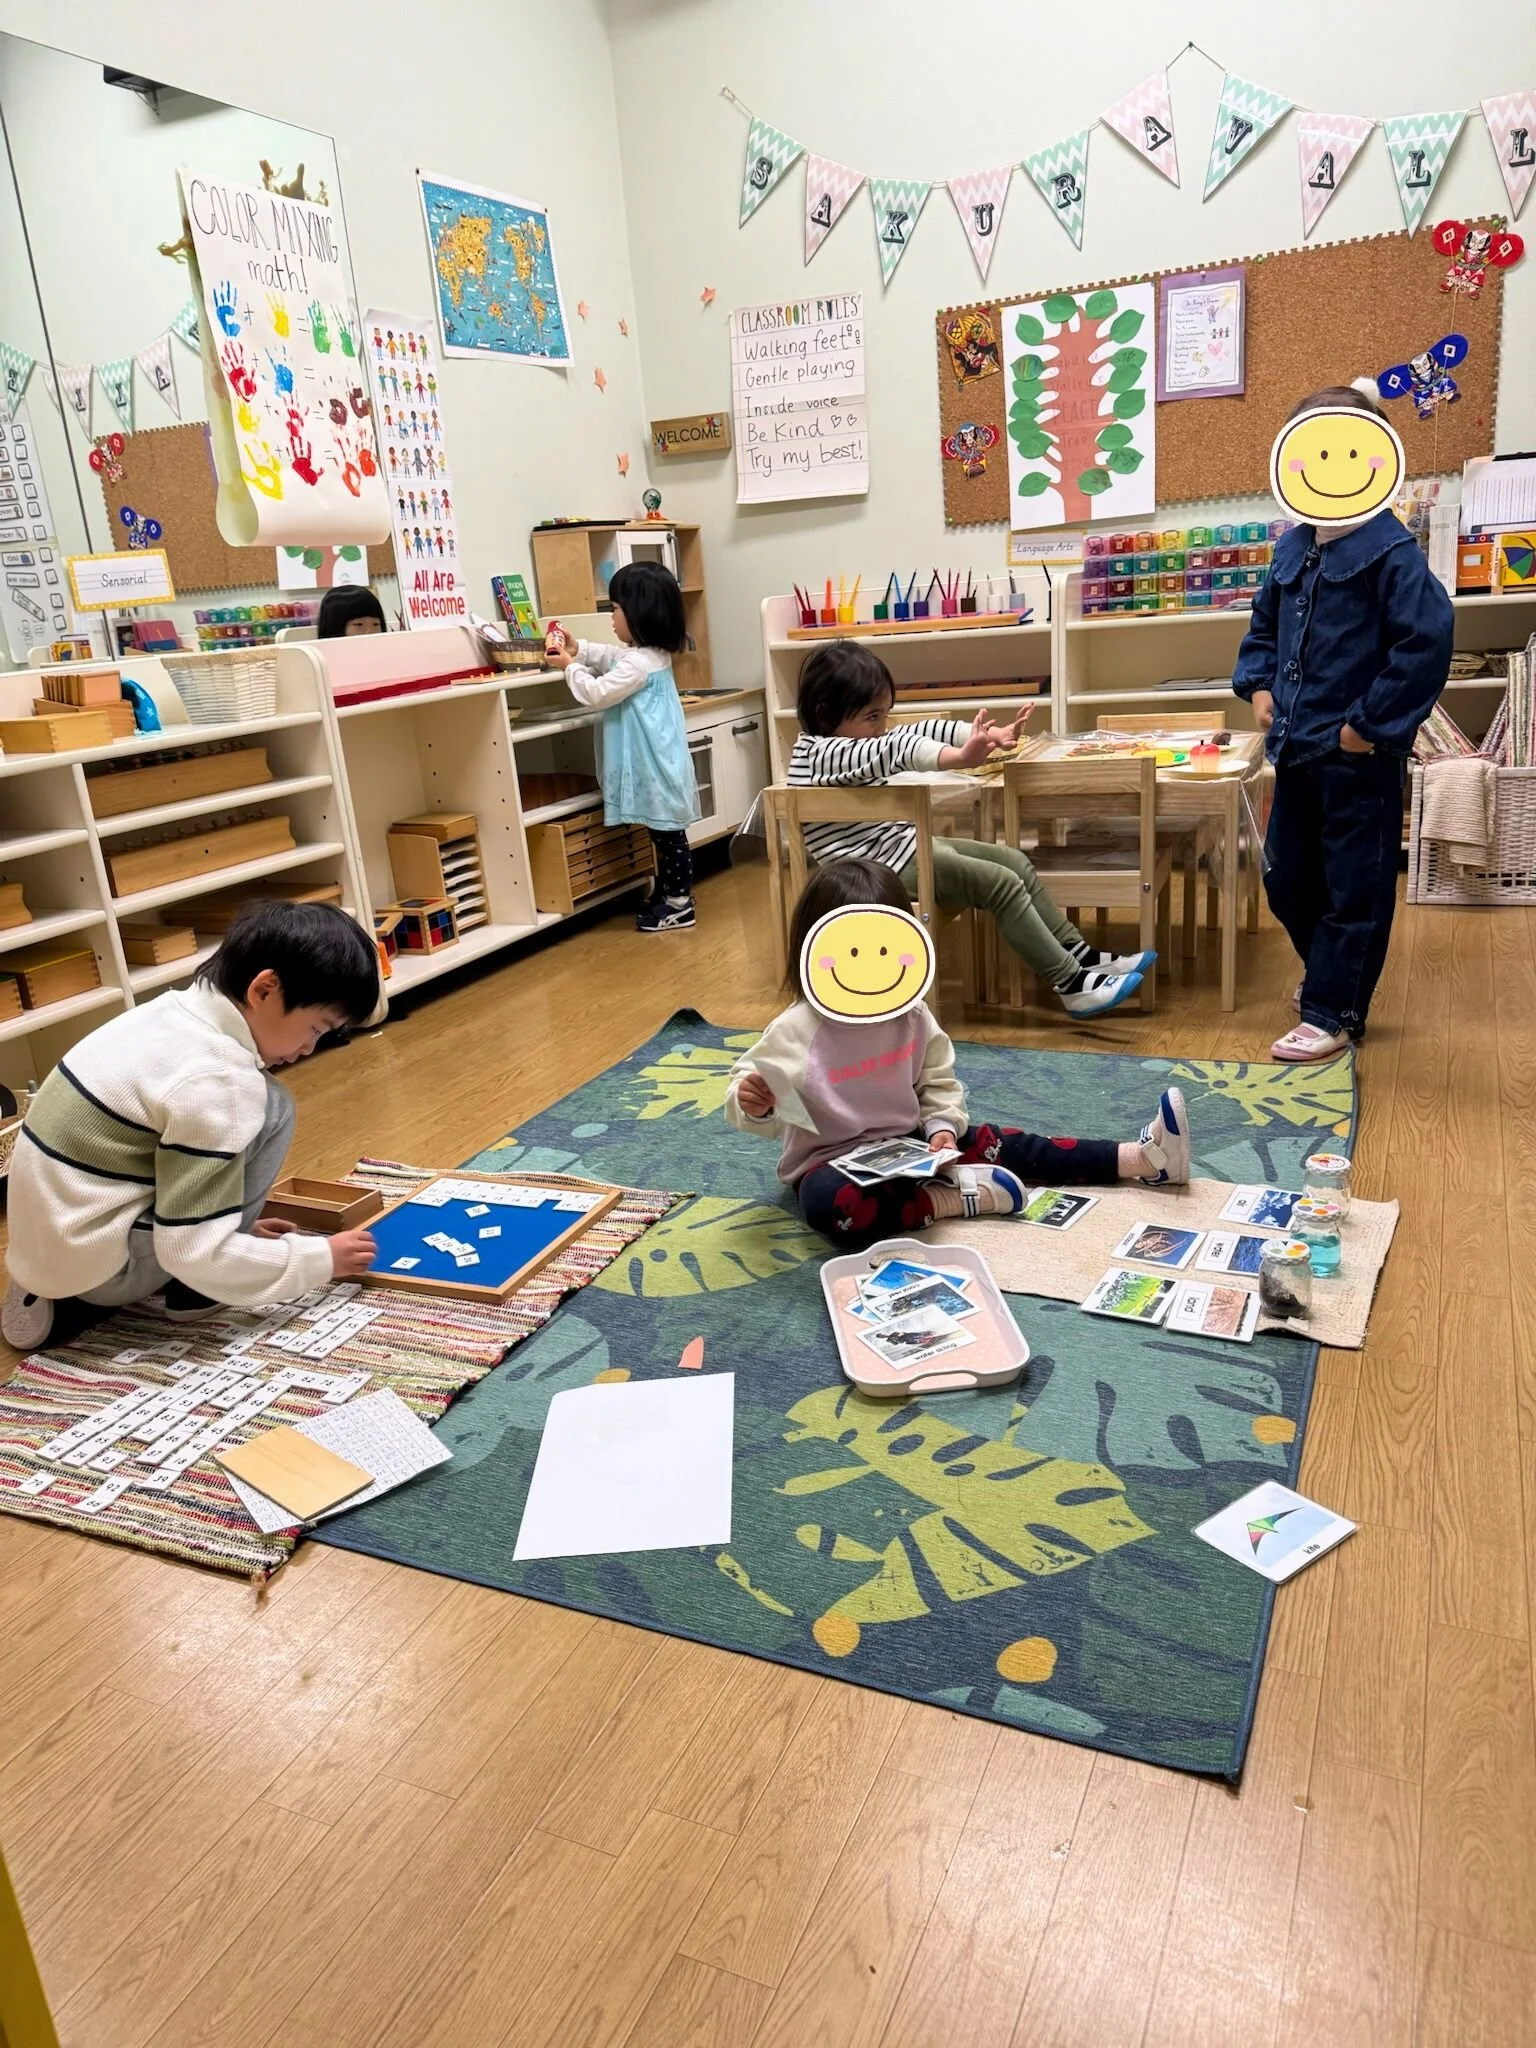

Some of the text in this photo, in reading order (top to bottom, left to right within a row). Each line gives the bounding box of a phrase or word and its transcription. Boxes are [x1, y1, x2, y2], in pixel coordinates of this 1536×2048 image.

[190, 179, 339, 264] COLOR MIXING
[248, 255, 308, 295] math!
[741, 295, 859, 334] CLASSROOM RULES
[745, 325, 849, 361] Walking feet
[745, 359, 855, 388] Gentle playing
[745, 396, 840, 418] Inside voice
[655, 424, 721, 444] WELCOME
[748, 417, 824, 442] Be Kind
[746, 440, 863, 478] Try my best!
[1016, 541, 1074, 556] Language Arts
[101, 570, 148, 588] Sensorial
[414, 570, 454, 592] All Are
[408, 594, 465, 619] Welcome
[1184, 1297, 1198, 1314] land
[914, 1351, 935, 1361] water
[1302, 1543, 1321, 1556] kite
